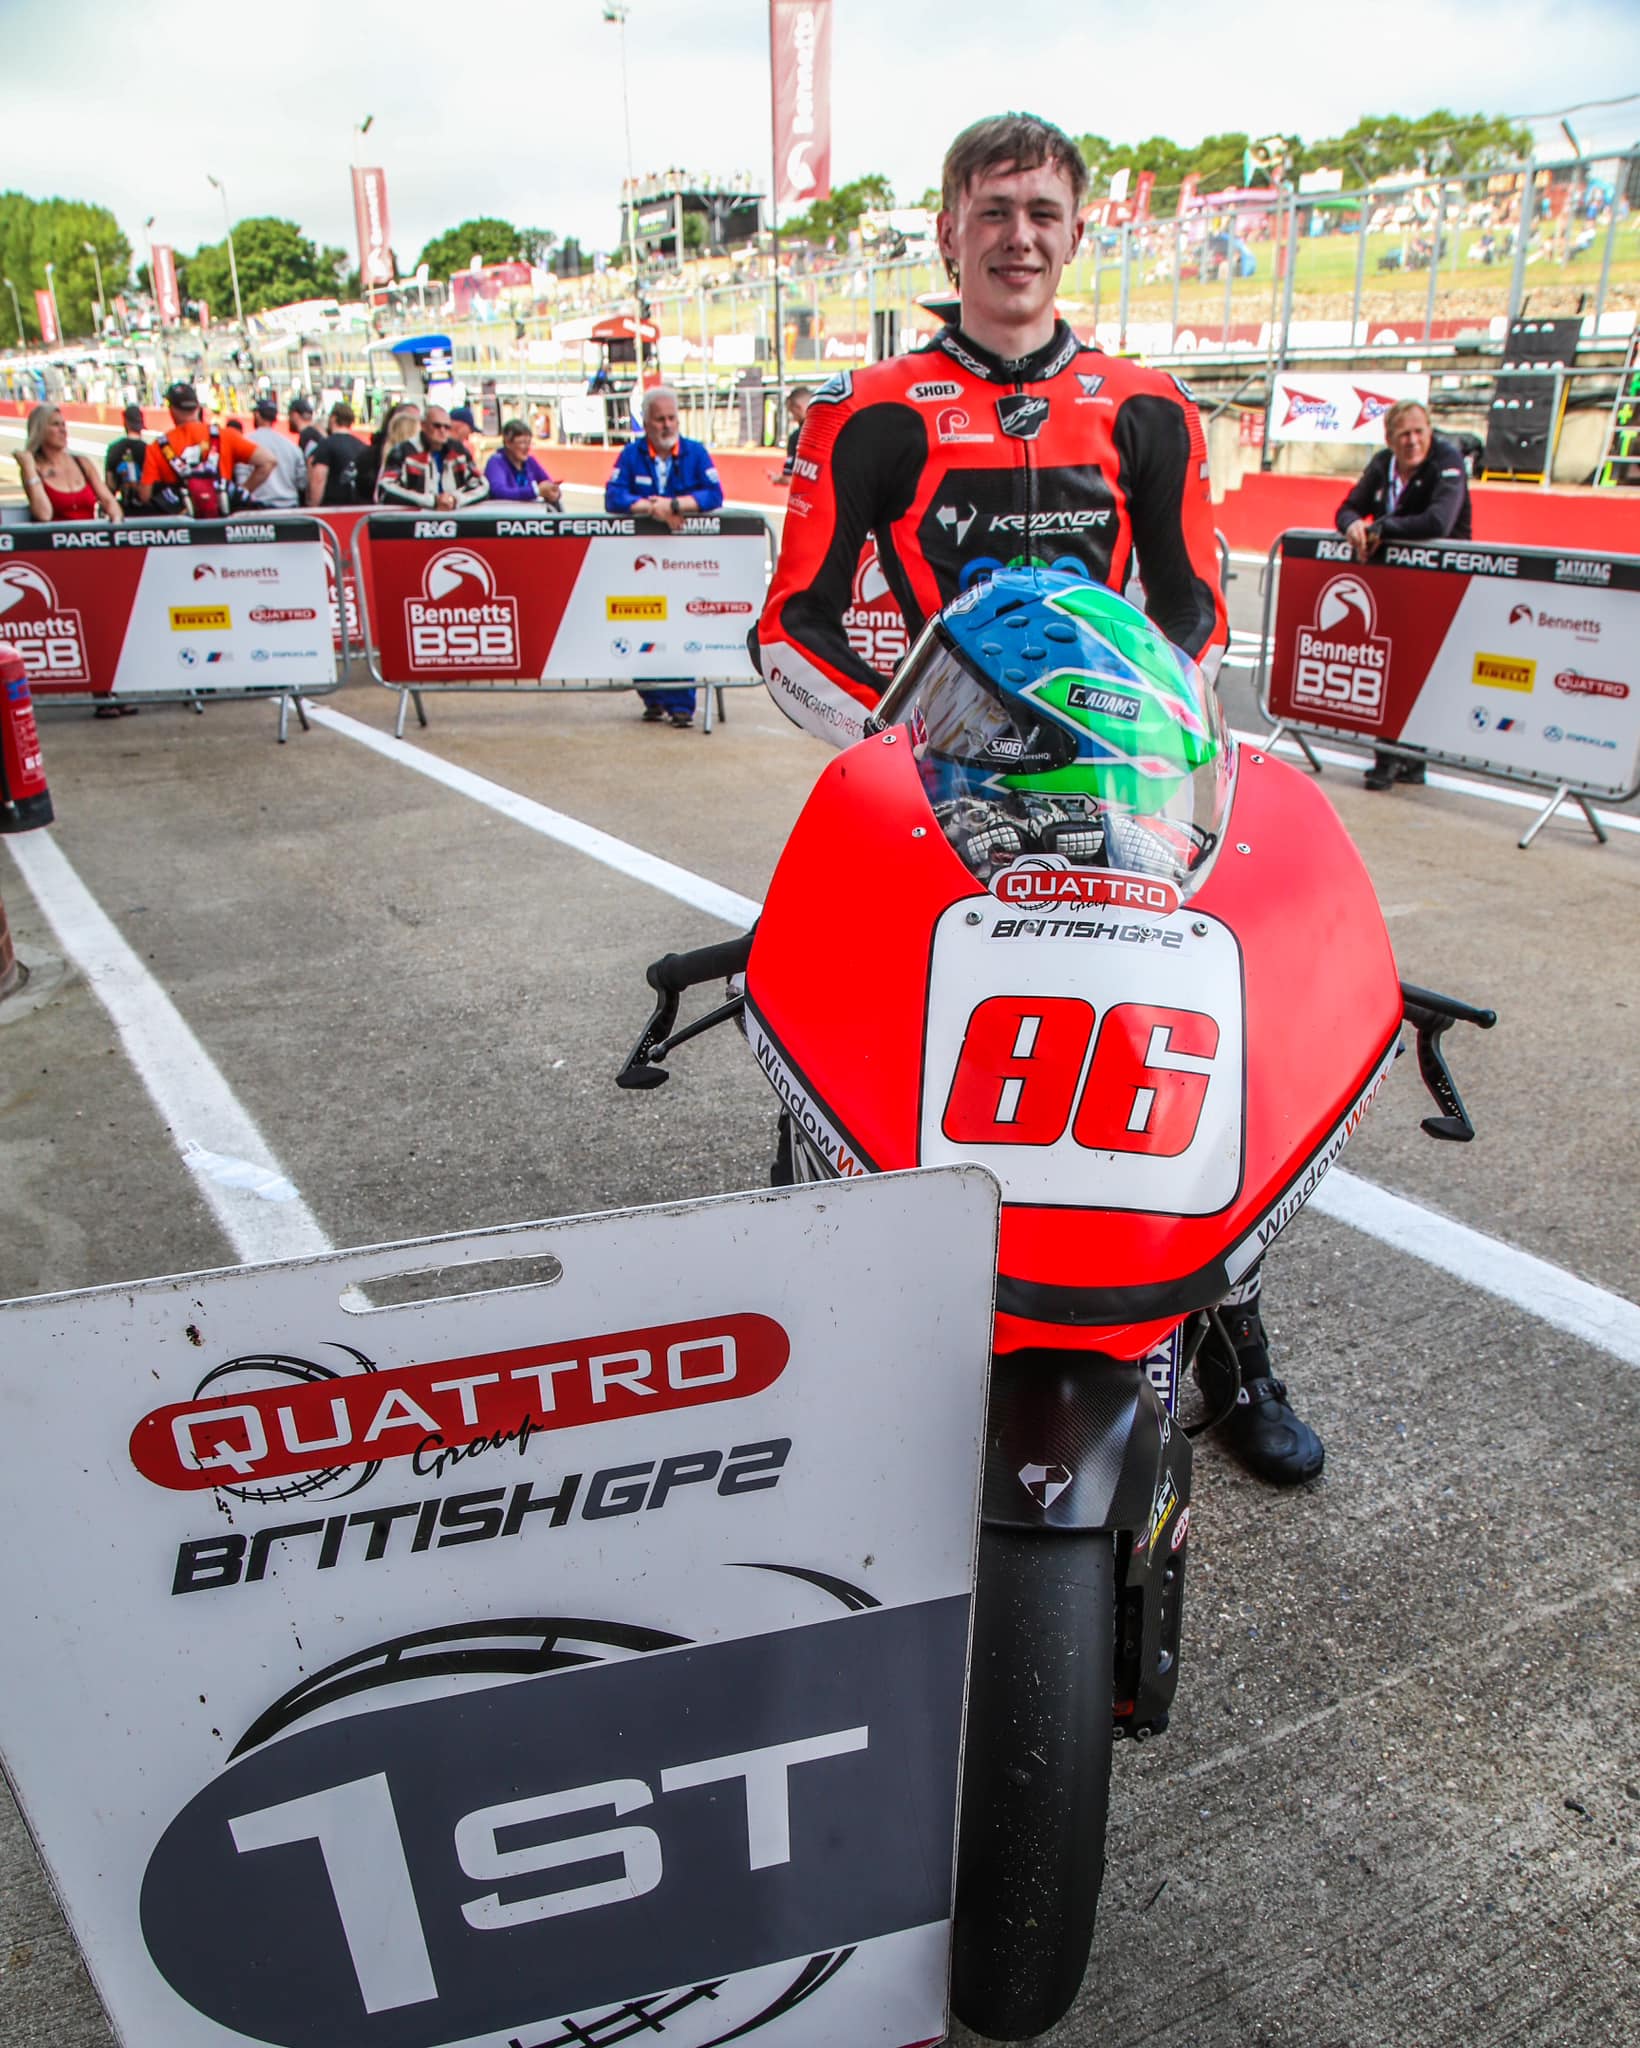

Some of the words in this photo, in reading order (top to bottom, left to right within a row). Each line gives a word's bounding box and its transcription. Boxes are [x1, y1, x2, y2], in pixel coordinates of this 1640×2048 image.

[915, 384, 956, 398] SHOEI
[793, 458, 818, 481] TUL
[52, 531, 109, 549] PARC
[114, 528, 191, 546] FERME
[414, 520, 457, 539] R&G
[496, 520, 555, 537] PARC
[558, 519, 636, 535] FERME
[1316, 540, 1352, 561] R&G
[1385, 545, 1440, 569] PARC
[1441, 550, 1519, 576] FERME
[221, 567, 280, 578] Bennetts
[661, 559, 719, 570] Bennetts
[251, 609, 312, 621] QUATTRO
[410, 603, 512, 624] Bennetts
[611, 603, 662, 615] PIRELLI
[688, 602, 748, 613] QUATTRO
[174, 612, 227, 626] PIRELLI
[1538, 612, 1601, 634] Bennetts
[412, 625, 514, 656] BSB
[1300, 633, 1385, 668] Bennetts
[0, 638, 81, 670] SB
[1296, 658, 1382, 706] BSB
[1477, 660, 1530, 684] PIRELLI
[1557, 673, 1625, 697] QUATTRO
[991, 740, 1022, 756] SHOEI
[1006, 873, 1168, 909] QUATTRO
[941, 994, 1221, 1159] 86
[171, 1334, 739, 1475] QUATTRO
[411, 1413, 545, 1479] Group
